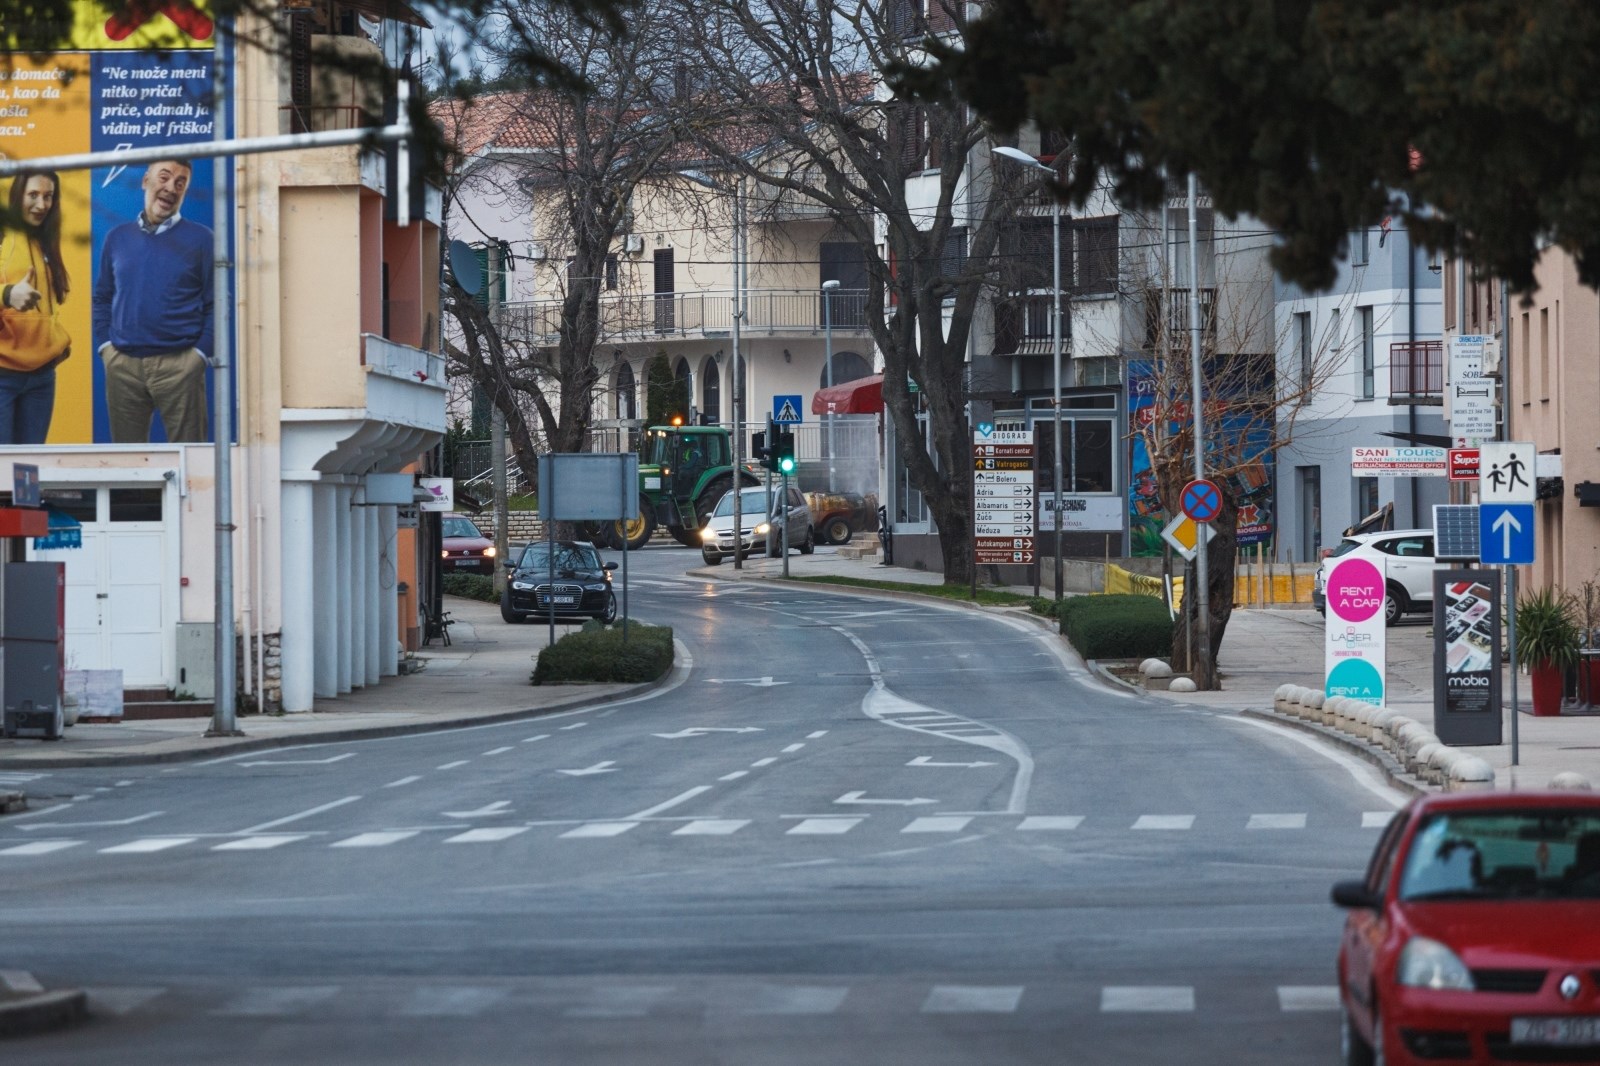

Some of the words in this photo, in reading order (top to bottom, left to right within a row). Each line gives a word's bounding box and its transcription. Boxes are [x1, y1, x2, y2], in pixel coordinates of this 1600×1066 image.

[131, 66, 168, 79] može
[171, 66, 206, 79] meni
[12, 86, 40, 98] kao
[42, 86, 60, 98] da
[102, 84, 138, 98] nitko
[140, 84, 183, 100] pričat
[0, 104, 28, 118] ošla
[101, 103, 140, 120] priče,
[144, 103, 193, 116] odmah
[102, 122, 140, 134] vidim
[1355, 448, 1388, 457] SANI
[1395, 448, 1444, 457] TOURS
[996, 461, 1028, 469] Vatrogasci
[977, 540, 1012, 548] Autokampovi
[1340, 587, 1374, 596] RENT
[1340, 599, 1349, 607] A
[1353, 599, 1380, 608] CAR
[1331, 633, 1371, 641] LAGER
[1448, 674, 1489, 686] mobia
